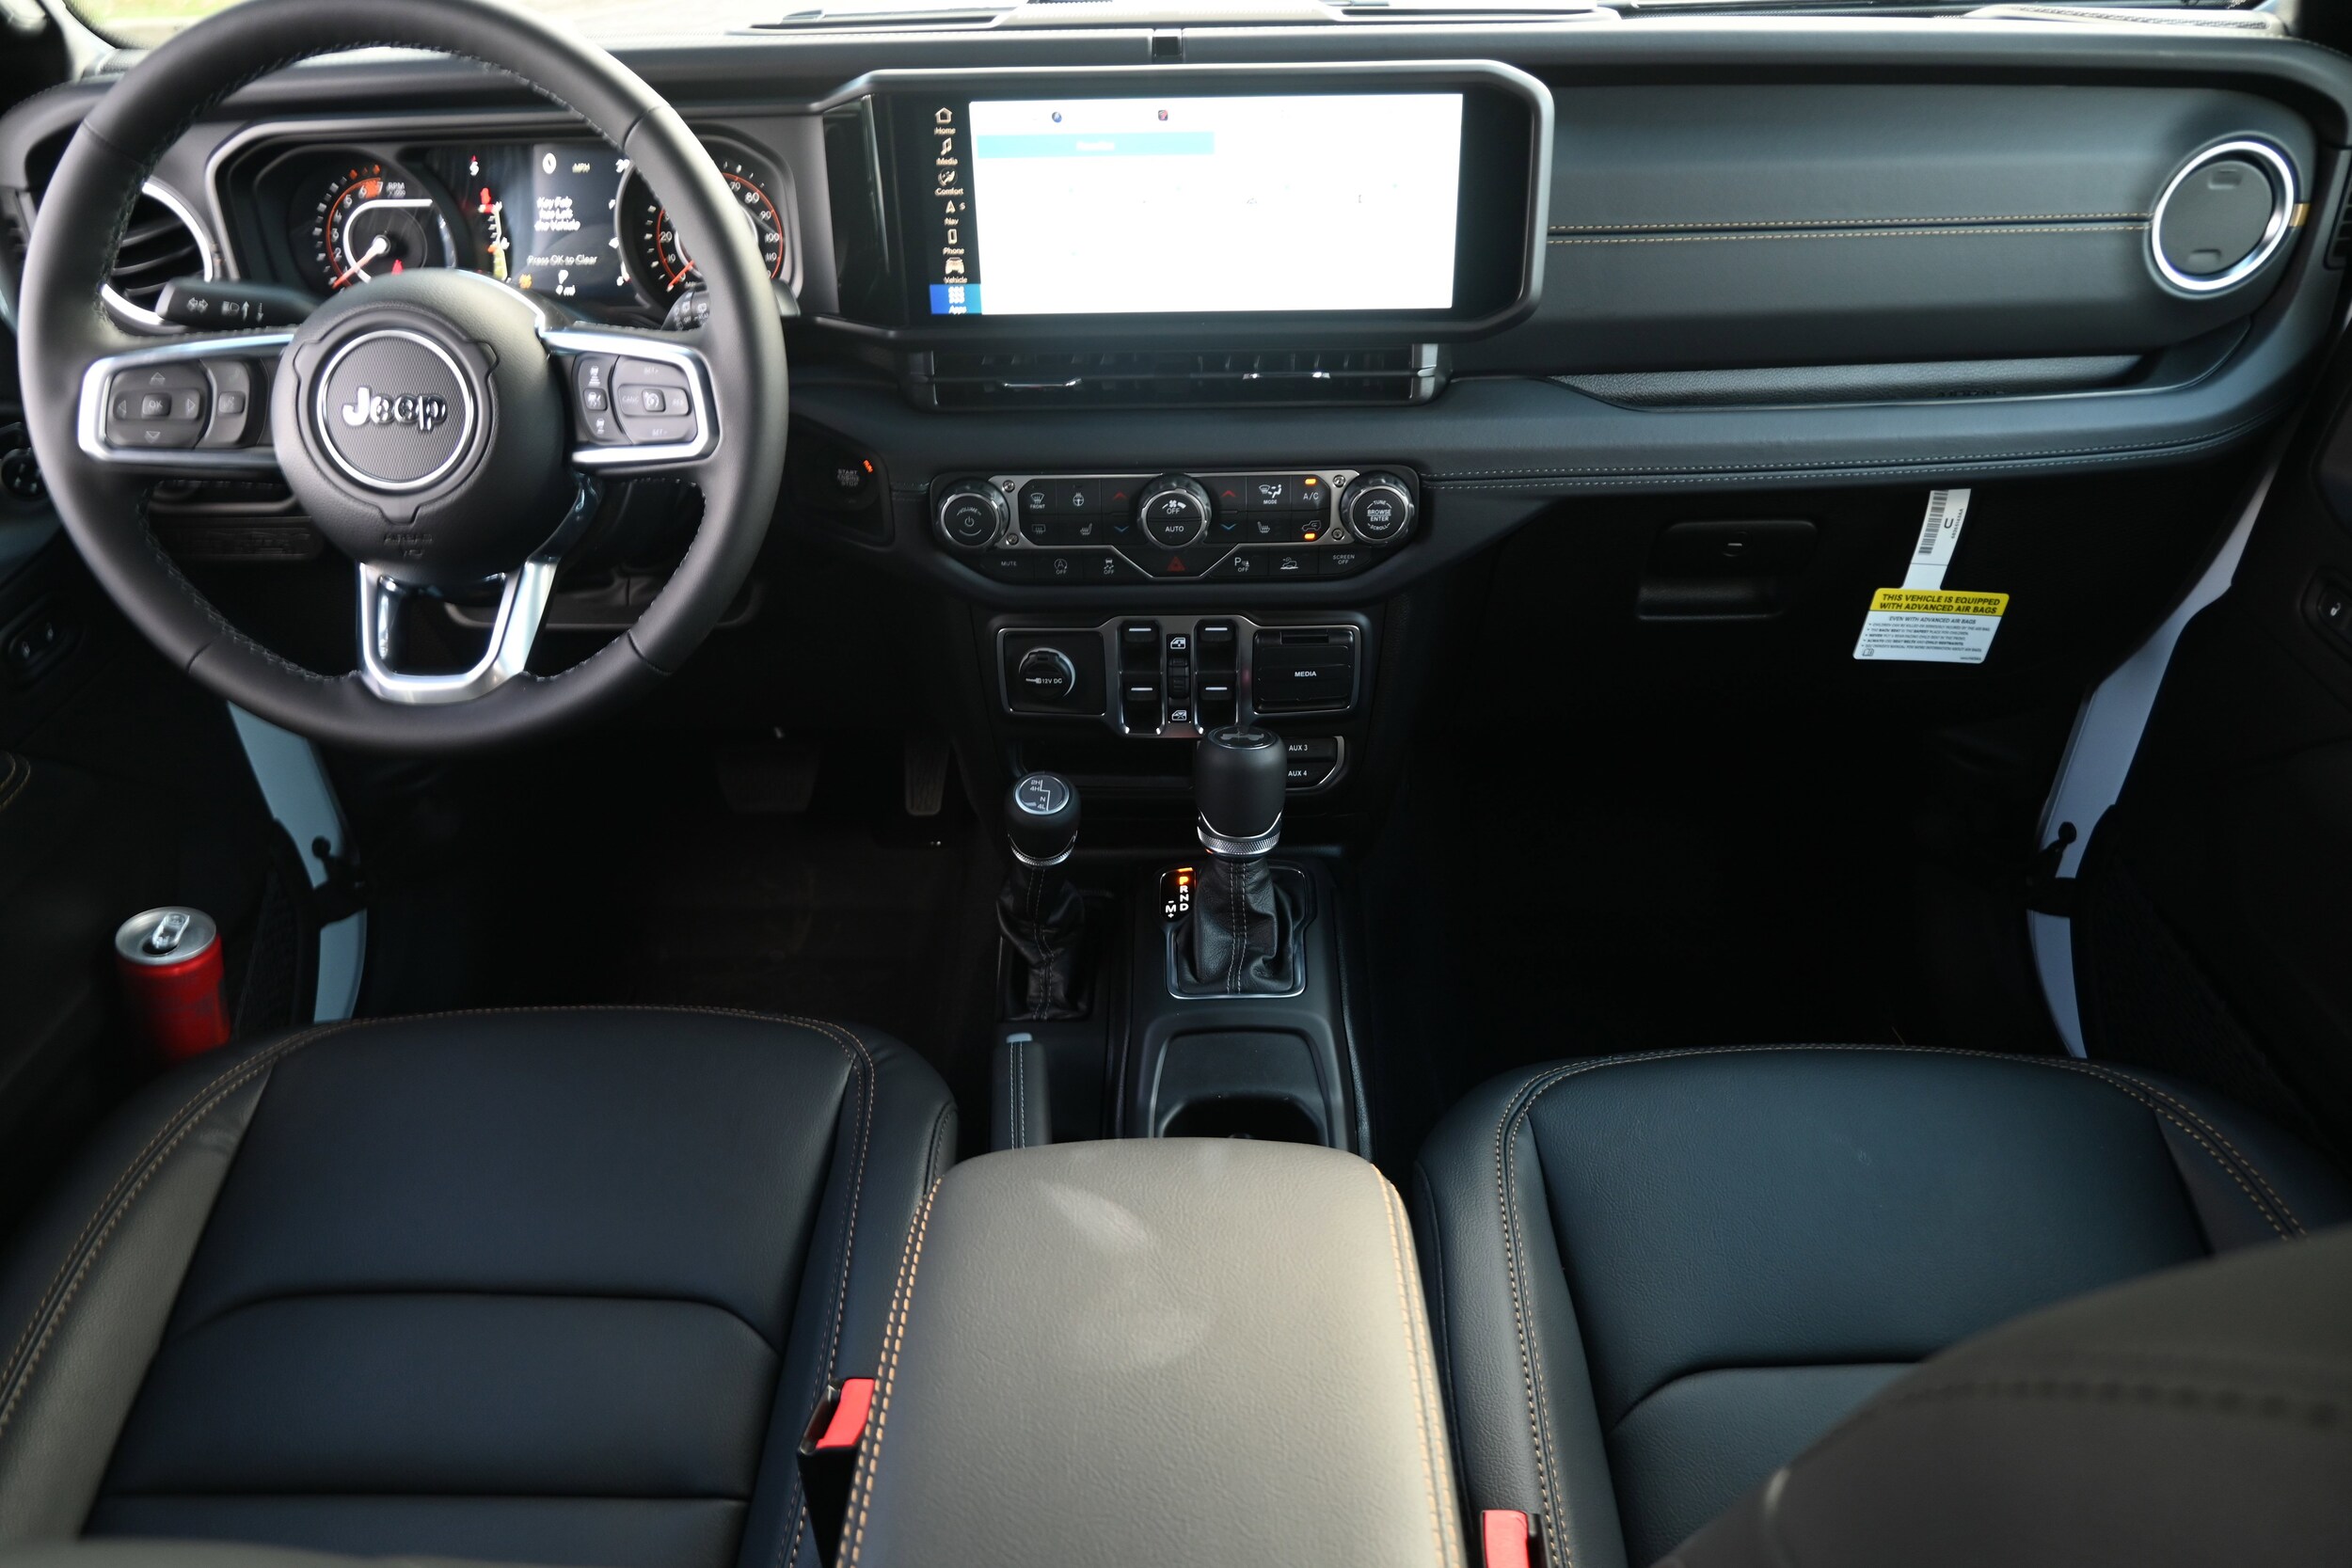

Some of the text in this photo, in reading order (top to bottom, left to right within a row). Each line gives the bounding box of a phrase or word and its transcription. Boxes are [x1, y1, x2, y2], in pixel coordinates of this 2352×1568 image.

[934, 127, 956, 135] Home
[572, 162, 591, 173] MPH
[358, 185, 368, 199] 6
[387, 182, 405, 193] RPM
[935, 187, 963, 197] Comfort
[343, 195, 353, 209] 5
[745, 192, 759, 204] 80
[334, 210, 342, 224] 4
[759, 211, 771, 221] 90
[945, 217, 959, 226] Nav
[331, 229, 340, 243] 3
[660, 231, 673, 244] 20
[765, 232, 780, 243] 100
[334, 247, 342, 261] 2
[943, 246, 964, 255] Phone
[527, 254, 597, 265] Press OK to Clear
[668, 253, 676, 262] 10
[766, 253, 777, 261] 110
[948, 305, 967, 315] Apps
[149, 400, 163, 408] OK
[342, 387, 449, 432] Jeep
[1303, 492, 1319, 500] A/C
[960, 506, 978, 515] VOLUME
[1944, 517, 1954, 529] U
[1234, 557, 1242, 566] P
[1905, 594, 1942, 603] VEHICLE
[1955, 596, 2000, 606] EQUIPPED
[1904, 603, 1954, 612] ADVANCED
[1180, 876, 1189, 885] P
[1180, 885, 1188, 894] R
[1180, 894, 1189, 902] N
[1166, 904, 1176, 913] M
[1180, 903, 1189, 911] D
